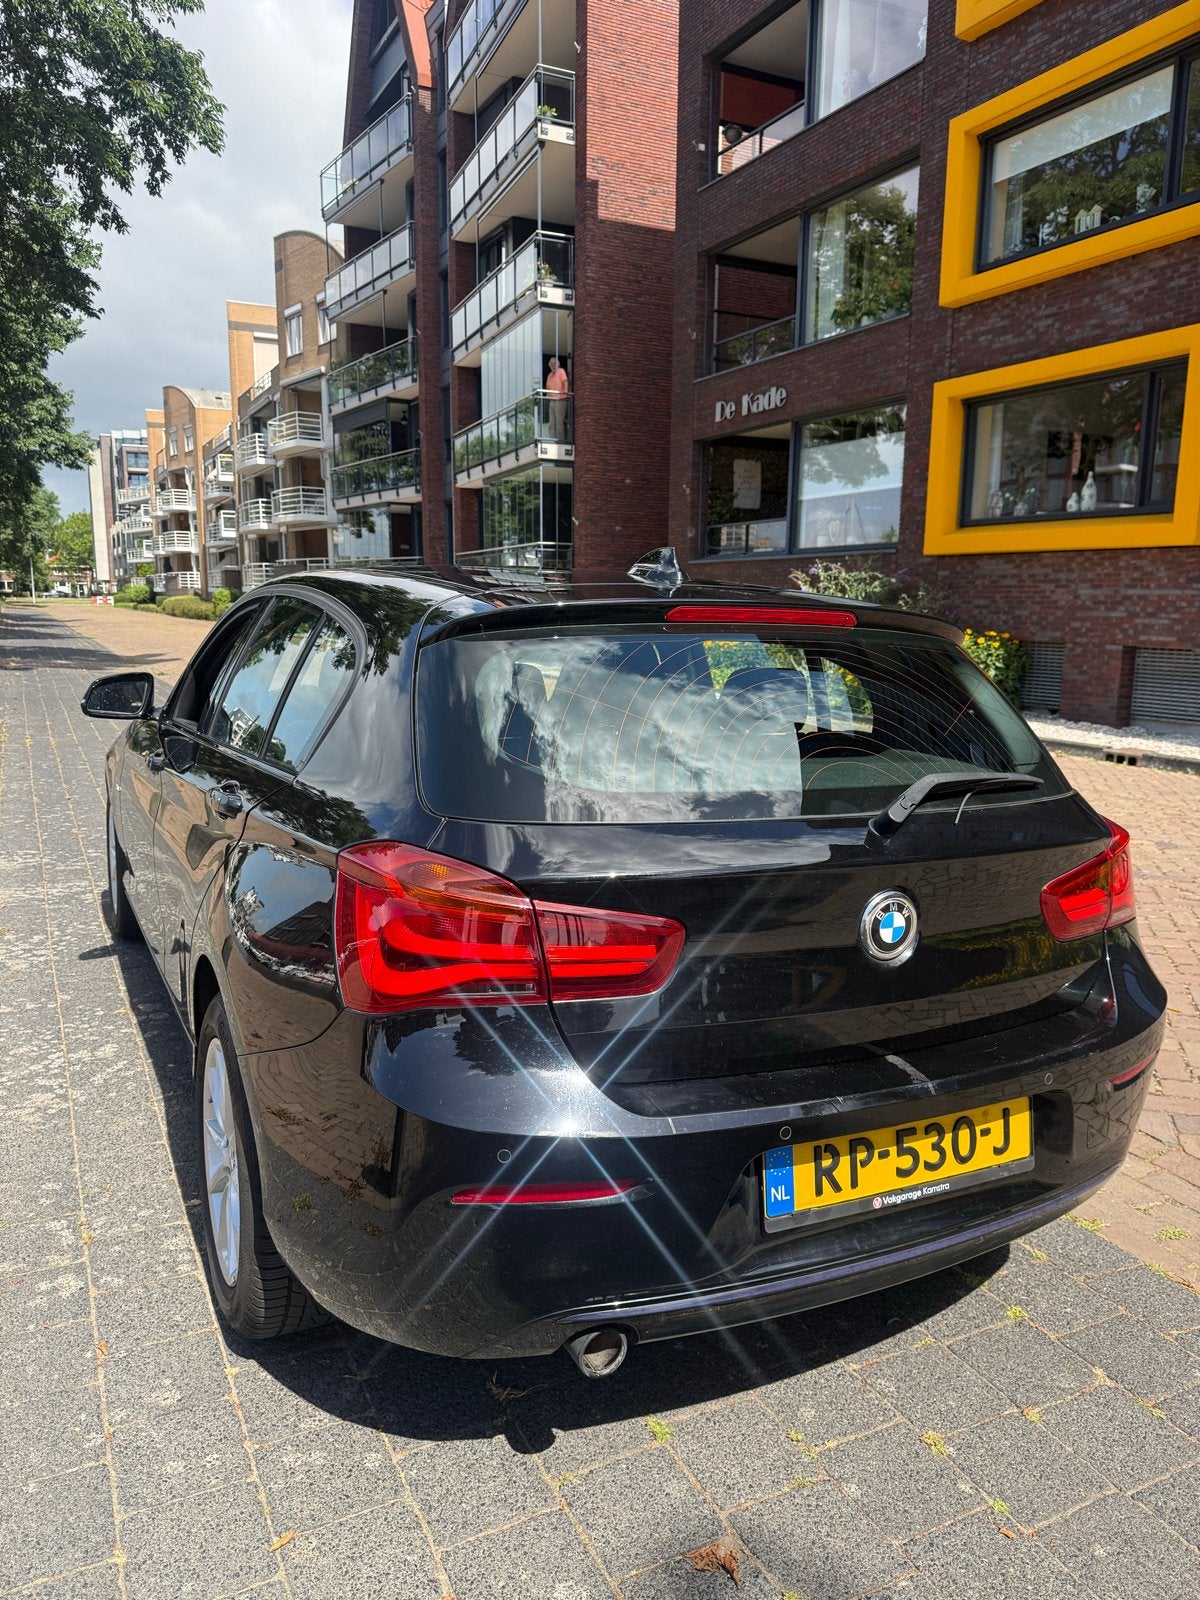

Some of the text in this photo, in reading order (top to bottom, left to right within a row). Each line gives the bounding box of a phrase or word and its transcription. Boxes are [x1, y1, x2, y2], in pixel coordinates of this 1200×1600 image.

[715, 387, 786, 422] De Kade
[876, 902, 911, 920] BMW
[813, 1107, 1011, 1198] RP-530-J
[771, 1186, 790, 1202] NL
[882, 1190, 922, 1204] Vakgarage
[922, 1182, 950, 1195] Kamstra
